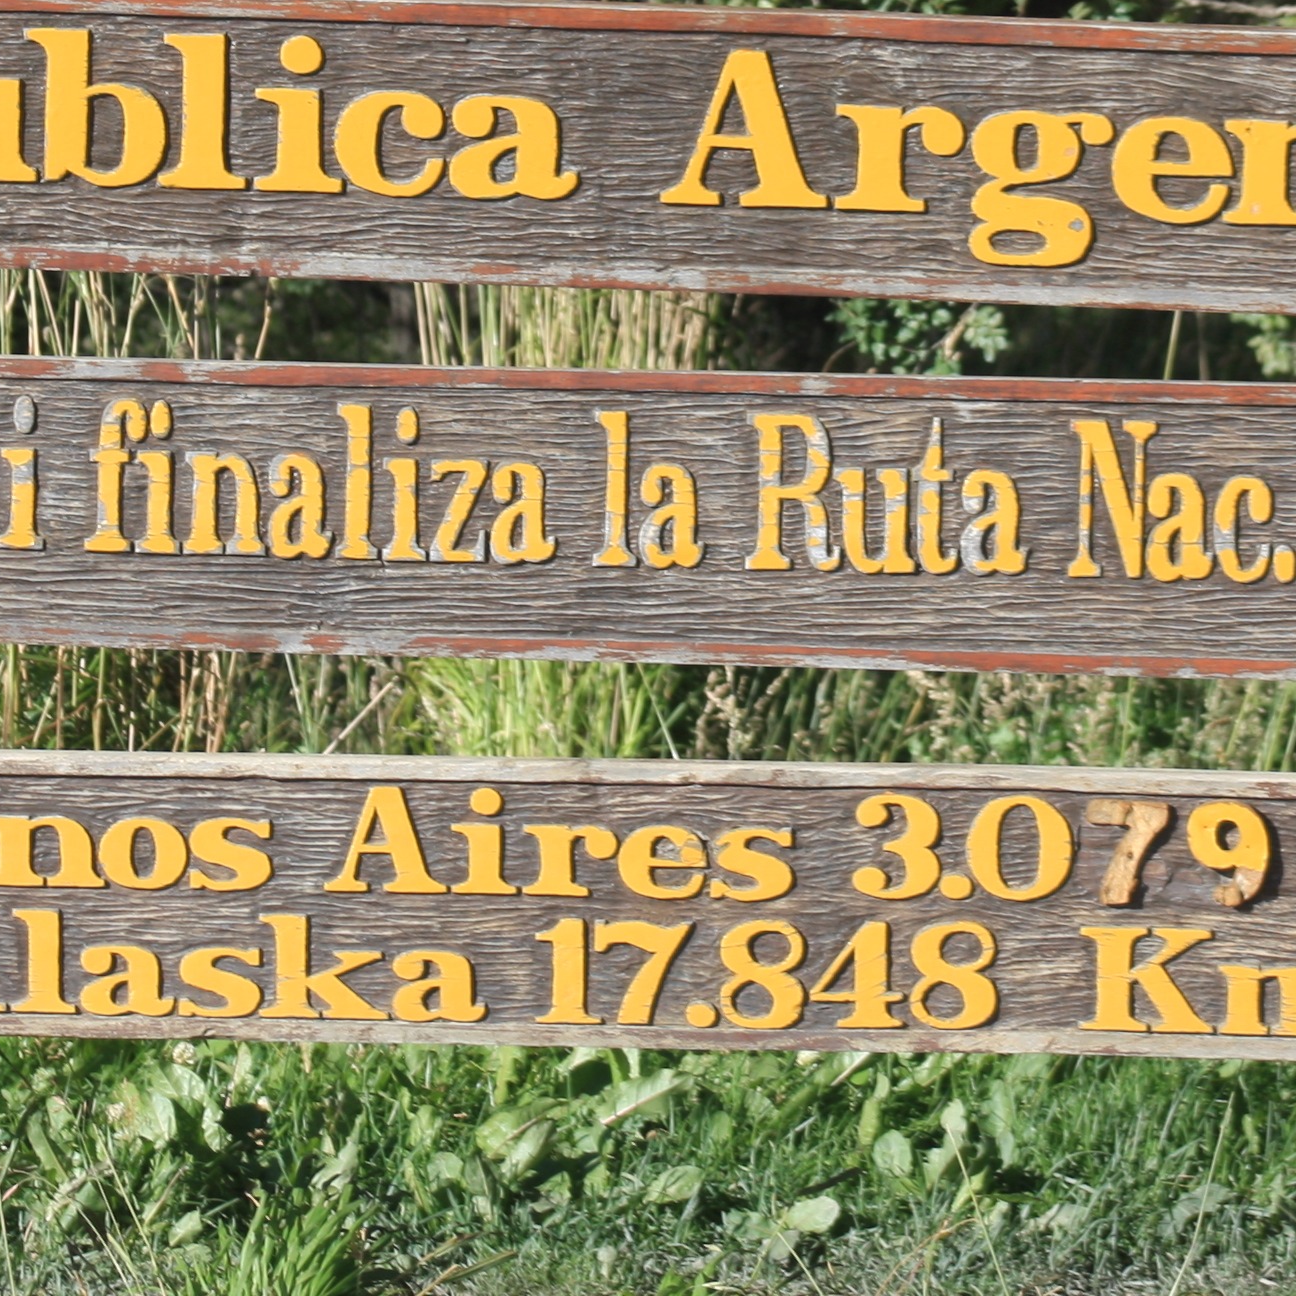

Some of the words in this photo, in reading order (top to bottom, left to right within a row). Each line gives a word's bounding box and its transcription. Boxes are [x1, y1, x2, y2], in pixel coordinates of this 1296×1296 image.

[85, 398, 558, 565] finaliza
[593, 410, 703, 572] la
[748, 412, 1029, 577] Ruta
[324, 784, 797, 906] Aires
[537, 917, 1001, 1033] 17.848
